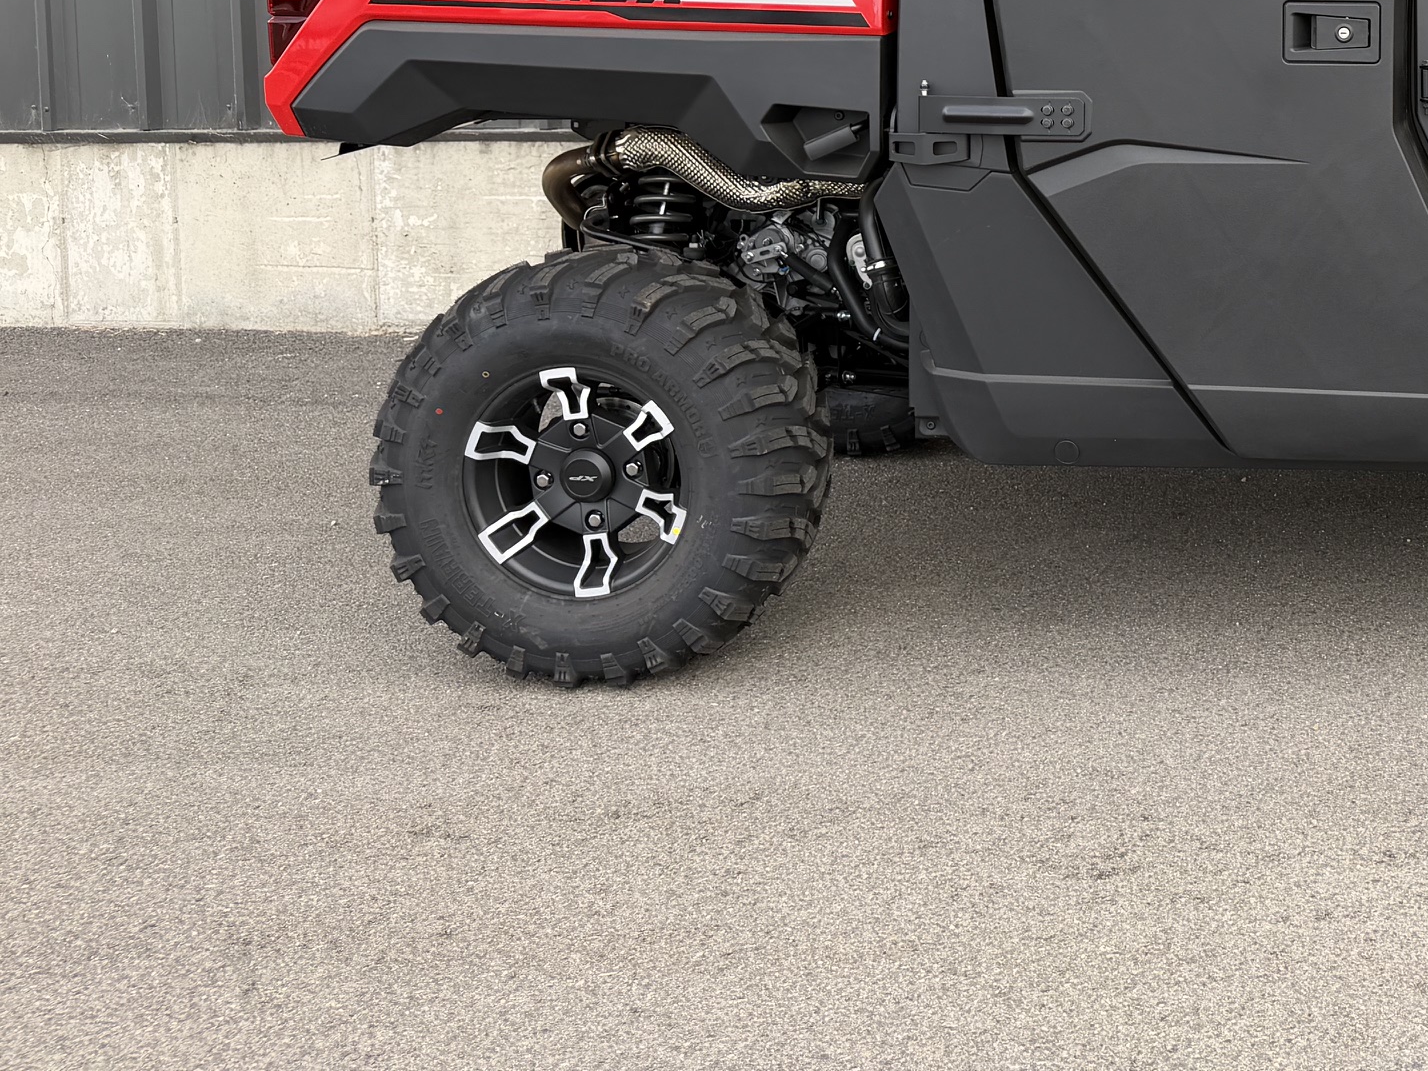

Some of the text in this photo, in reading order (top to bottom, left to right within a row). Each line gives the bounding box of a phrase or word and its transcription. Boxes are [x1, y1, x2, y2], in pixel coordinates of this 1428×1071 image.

[609, 342, 706, 438] PRO ARMOR
[418, 518, 526, 630] X-TERRAIN
